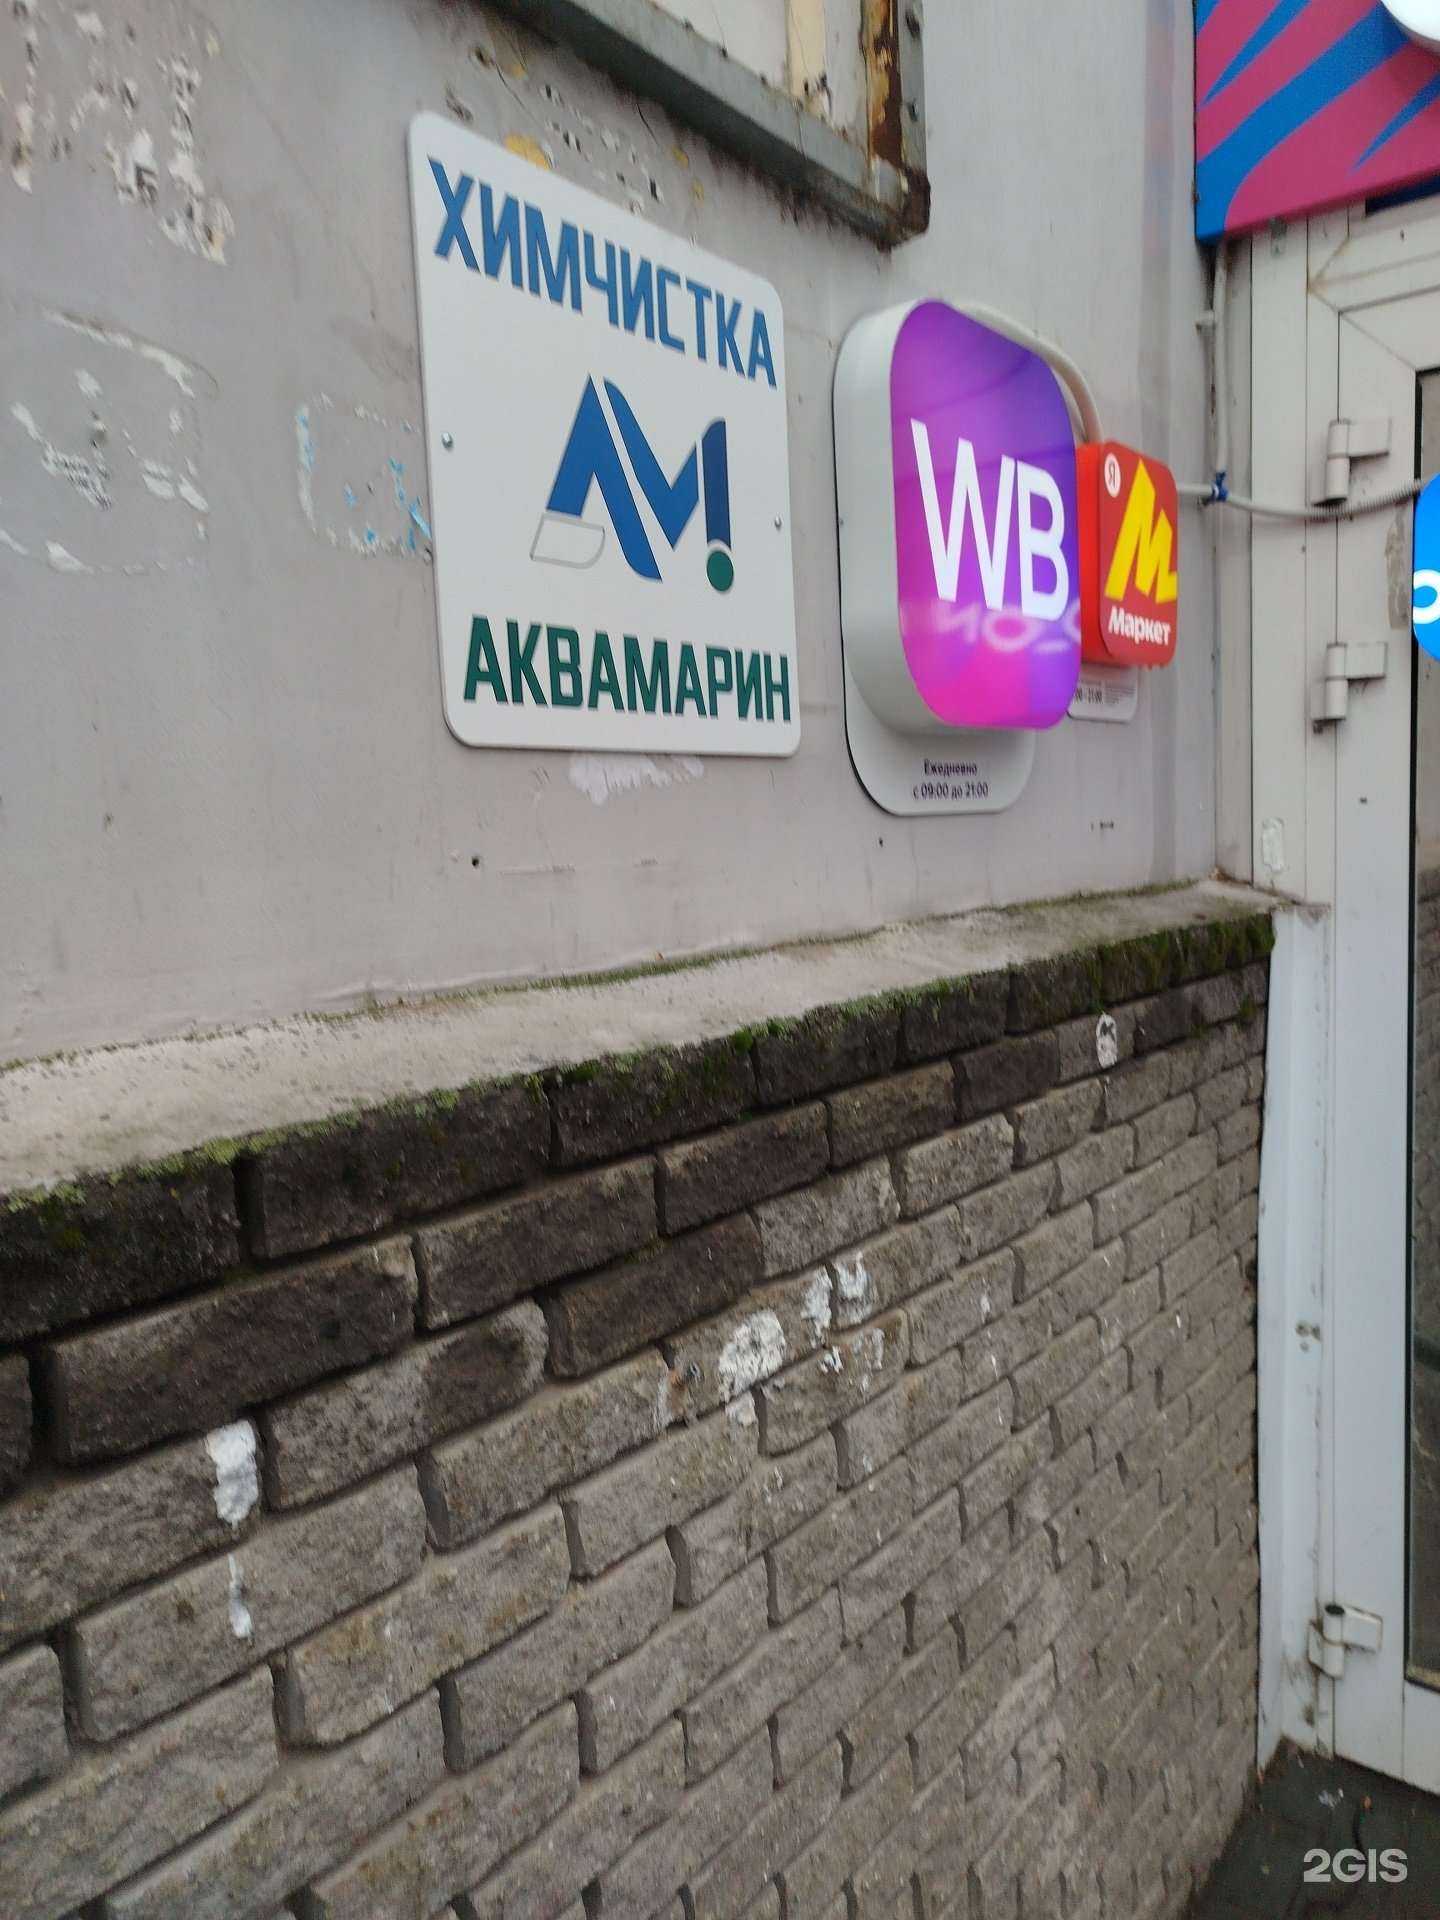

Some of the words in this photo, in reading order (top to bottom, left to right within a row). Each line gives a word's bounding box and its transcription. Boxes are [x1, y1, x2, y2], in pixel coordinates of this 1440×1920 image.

[428, 155, 777, 389] ХИМЧИСТКА
[910, 417, 1069, 621] WB
[1108, 606, 1171, 646] Маркет
[463, 613, 792, 724] АКВАМАРИН
[913, 786, 919, 800] с
[921, 782, 949, 799] 09:00
[952, 785, 963, 800] до
[965, 781, 989, 799] 21:00
[923, 759, 977, 777] Ежедневно
